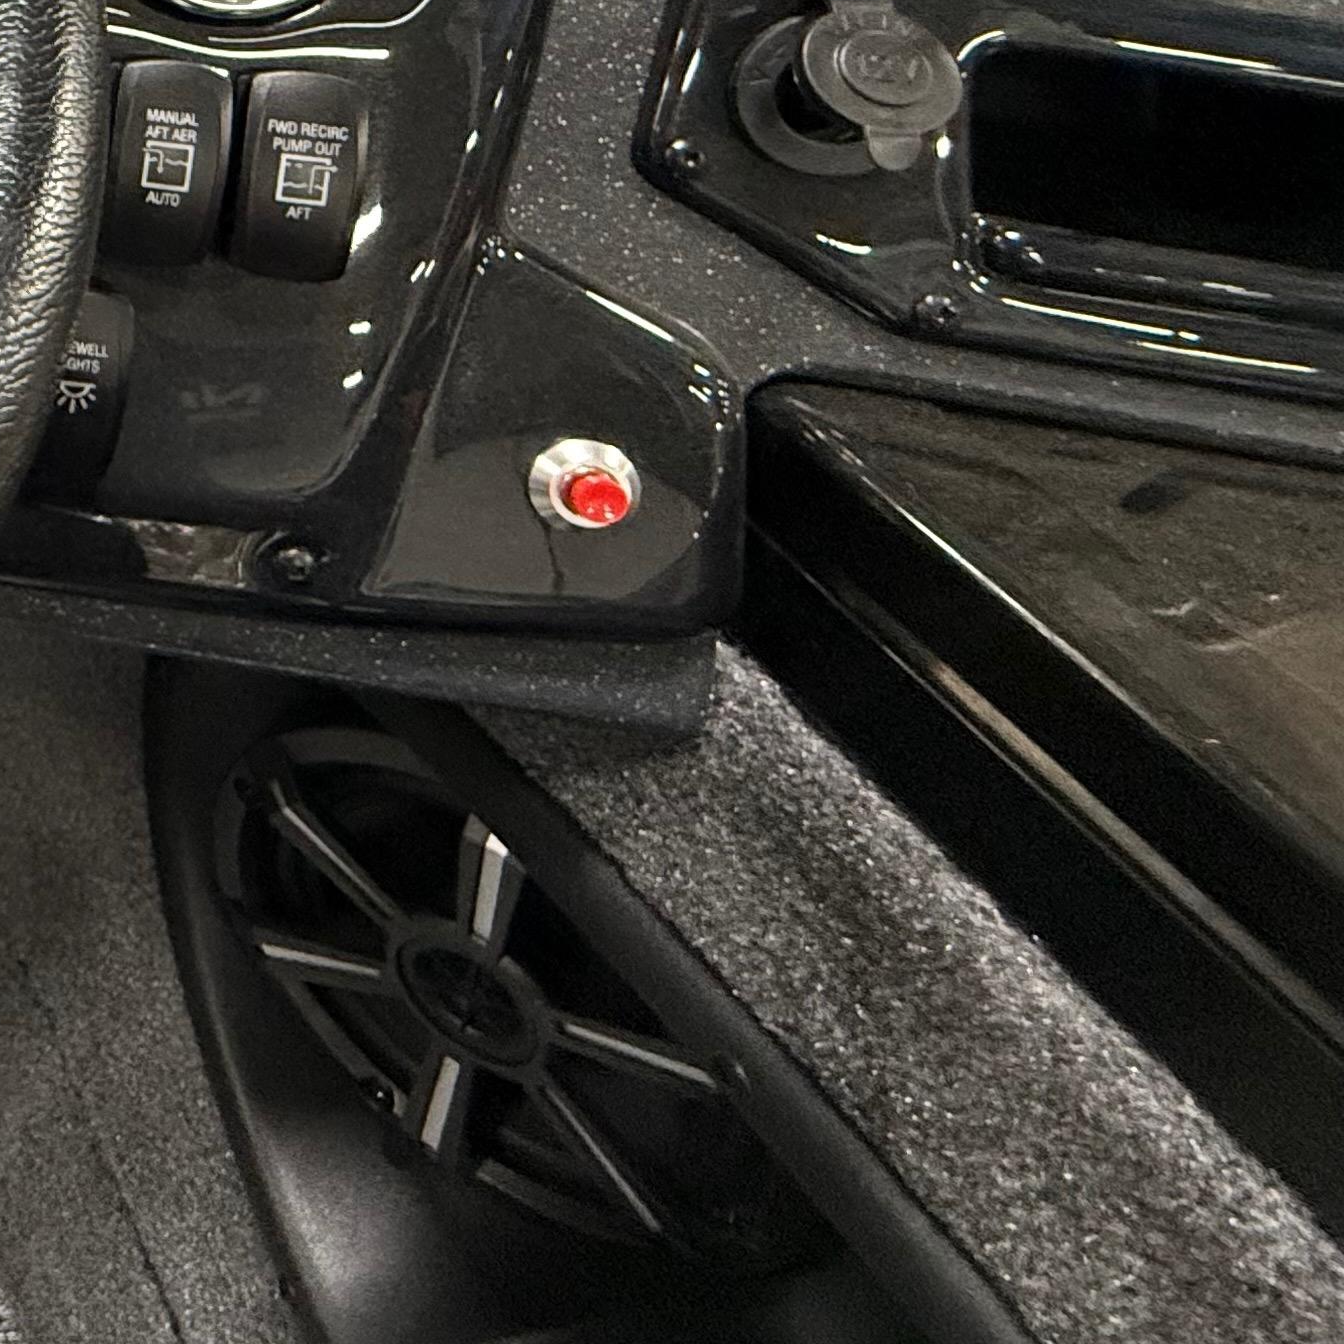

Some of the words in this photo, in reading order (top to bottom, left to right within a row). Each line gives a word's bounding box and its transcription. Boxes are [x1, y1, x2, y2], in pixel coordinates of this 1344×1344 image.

[146, 108, 199, 127] MANUAL
[145, 126, 169, 140] AFT
[171, 128, 198, 143] AER
[267, 118, 297, 135] FWD
[301, 122, 350, 142] RECIRC
[273, 138, 312, 153] PUMP
[315, 142, 342, 157] OUT
[145, 191, 181, 208] AUTO
[285, 206, 312, 221] AFT
